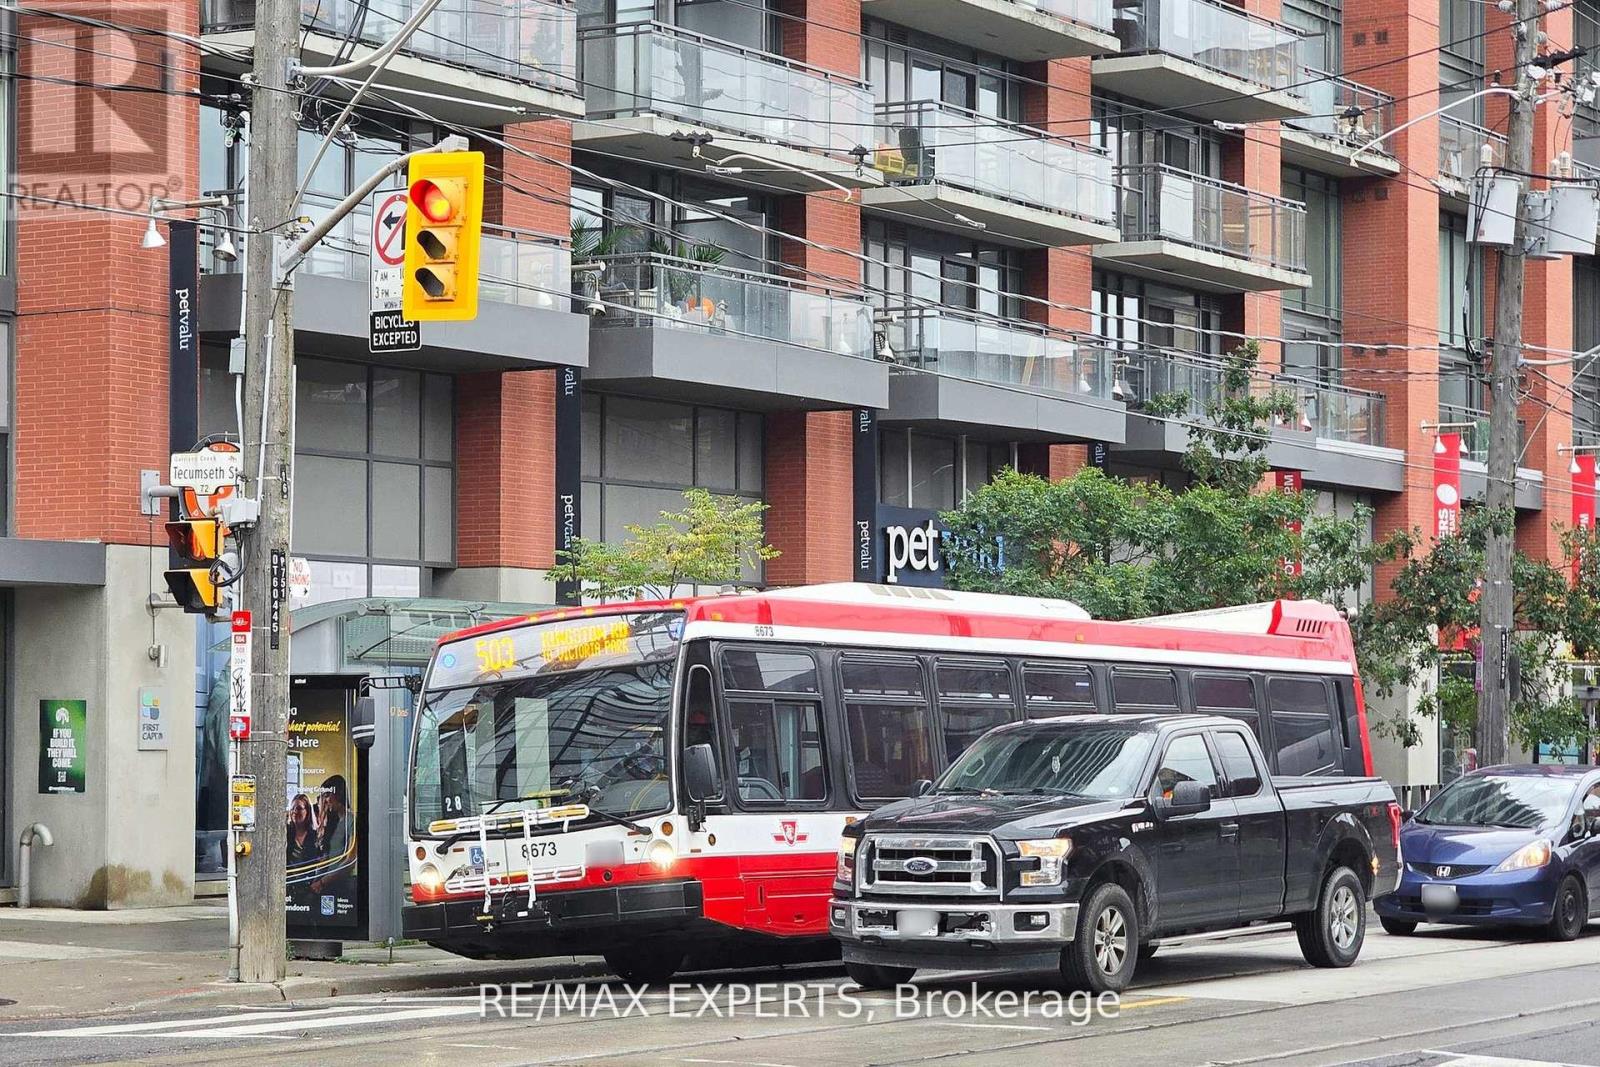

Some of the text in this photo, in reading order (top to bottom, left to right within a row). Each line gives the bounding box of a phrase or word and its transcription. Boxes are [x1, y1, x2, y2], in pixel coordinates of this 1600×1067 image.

[175, 288, 192, 351] petvalu
[373, 331, 417, 346] EXCEPTED
[173, 466, 225, 480] Tecumseth
[200, 484, 209, 493] 72
[857, 520, 872, 570] petvalu
[886, 519, 939, 583] pet
[475, 636, 515, 672] 503
[559, 639, 601, 662] VICTORIA
[604, 637, 630, 656] PARK
[142, 724, 160, 732] FIRST
[304, 720, 341, 735] potential
[296, 736, 319, 748] here
[521, 842, 558, 859] 8673
